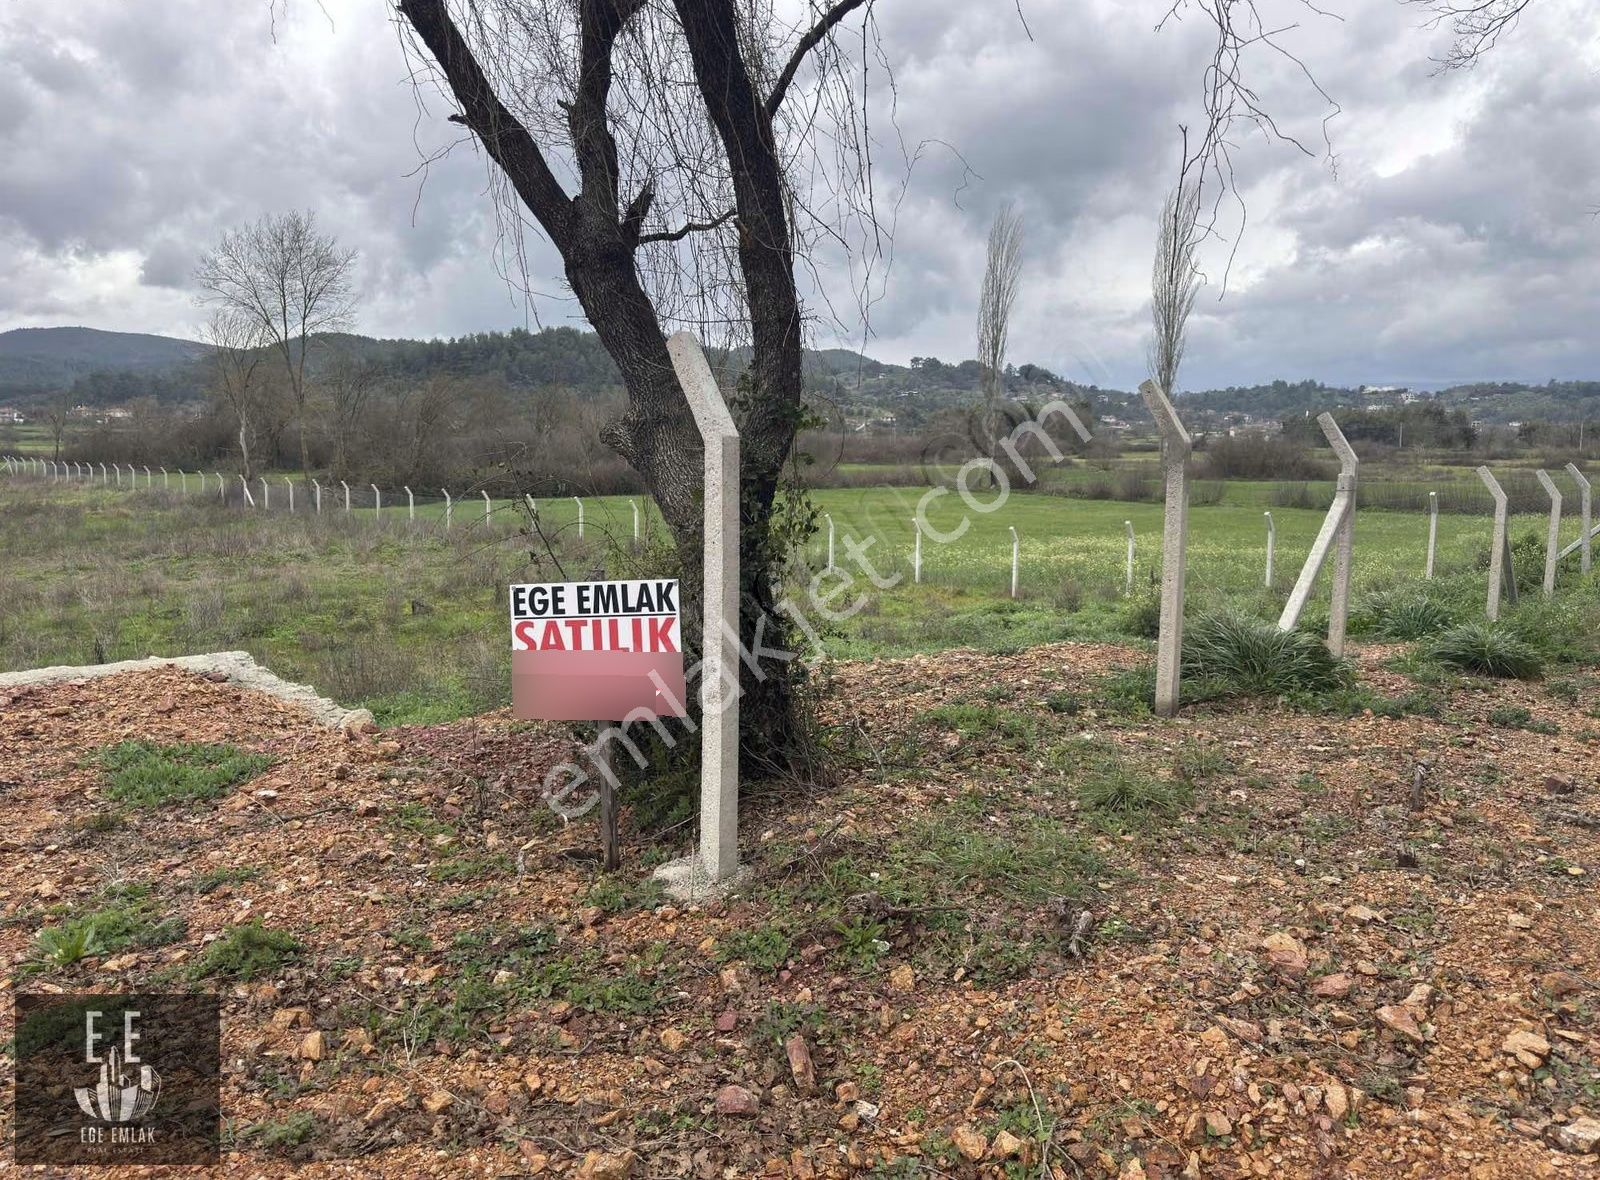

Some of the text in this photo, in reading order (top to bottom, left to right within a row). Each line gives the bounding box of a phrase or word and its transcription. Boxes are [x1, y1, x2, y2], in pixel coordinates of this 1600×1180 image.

[513, 582, 677, 616] EGE EMLAK
[514, 617, 678, 653] SATILIK
